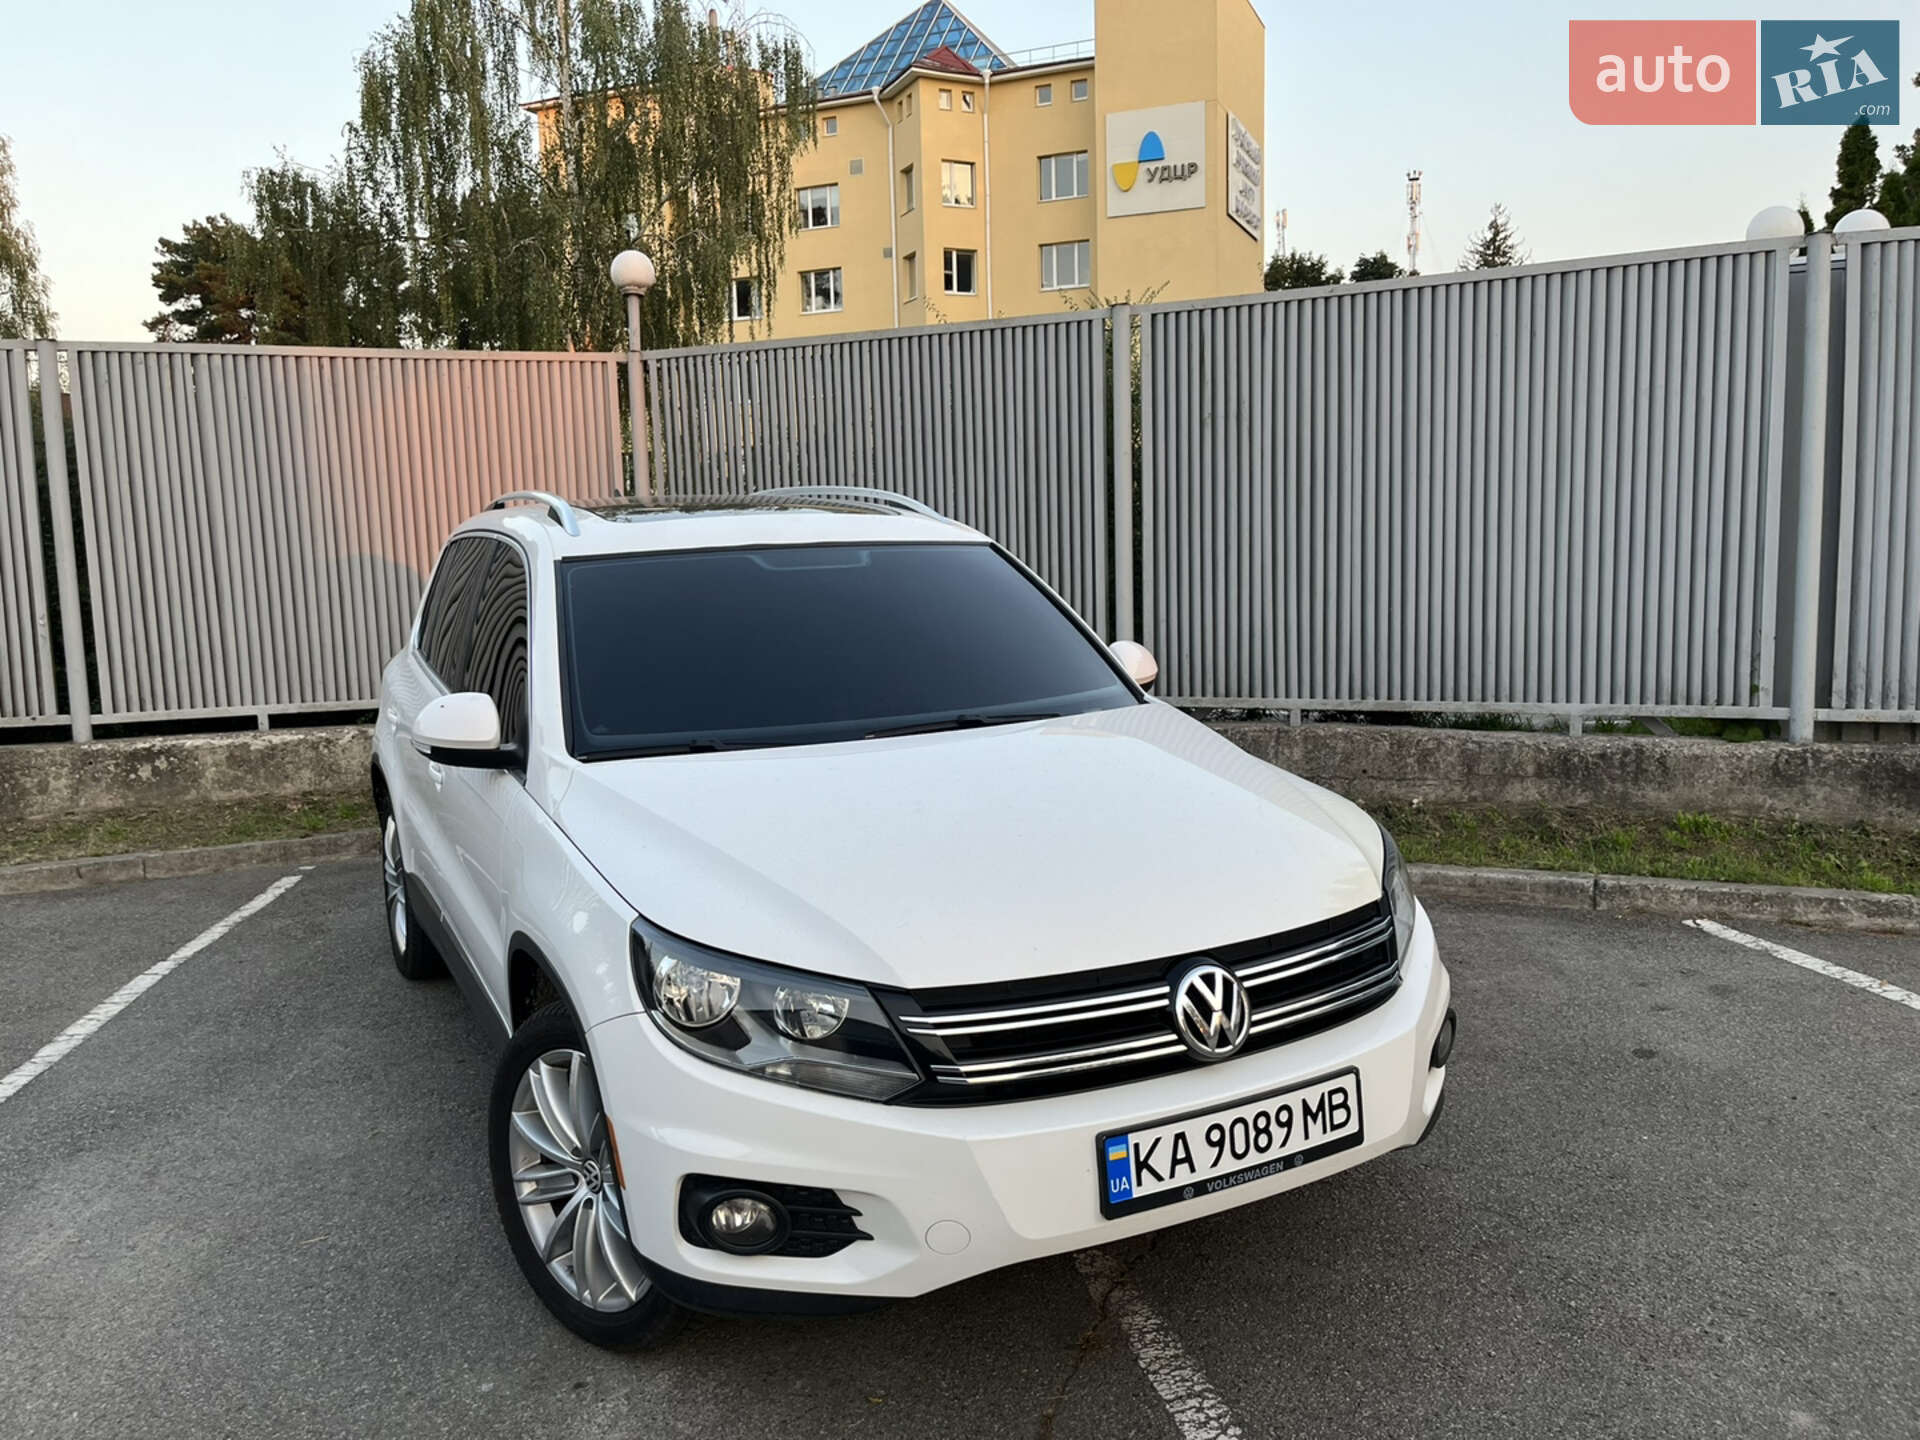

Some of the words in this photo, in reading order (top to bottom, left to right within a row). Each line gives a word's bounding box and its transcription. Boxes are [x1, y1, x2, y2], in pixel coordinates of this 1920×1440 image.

[1146, 162, 1199, 184] УДЦР
[1133, 1130, 1197, 1187] KA
[1205, 1103, 1294, 1169] 9089
[1301, 1086, 1351, 1141] MB
[1110, 1176, 1130, 1193] UA
[1206, 1160, 1285, 1193] VOLKSWAGEN
